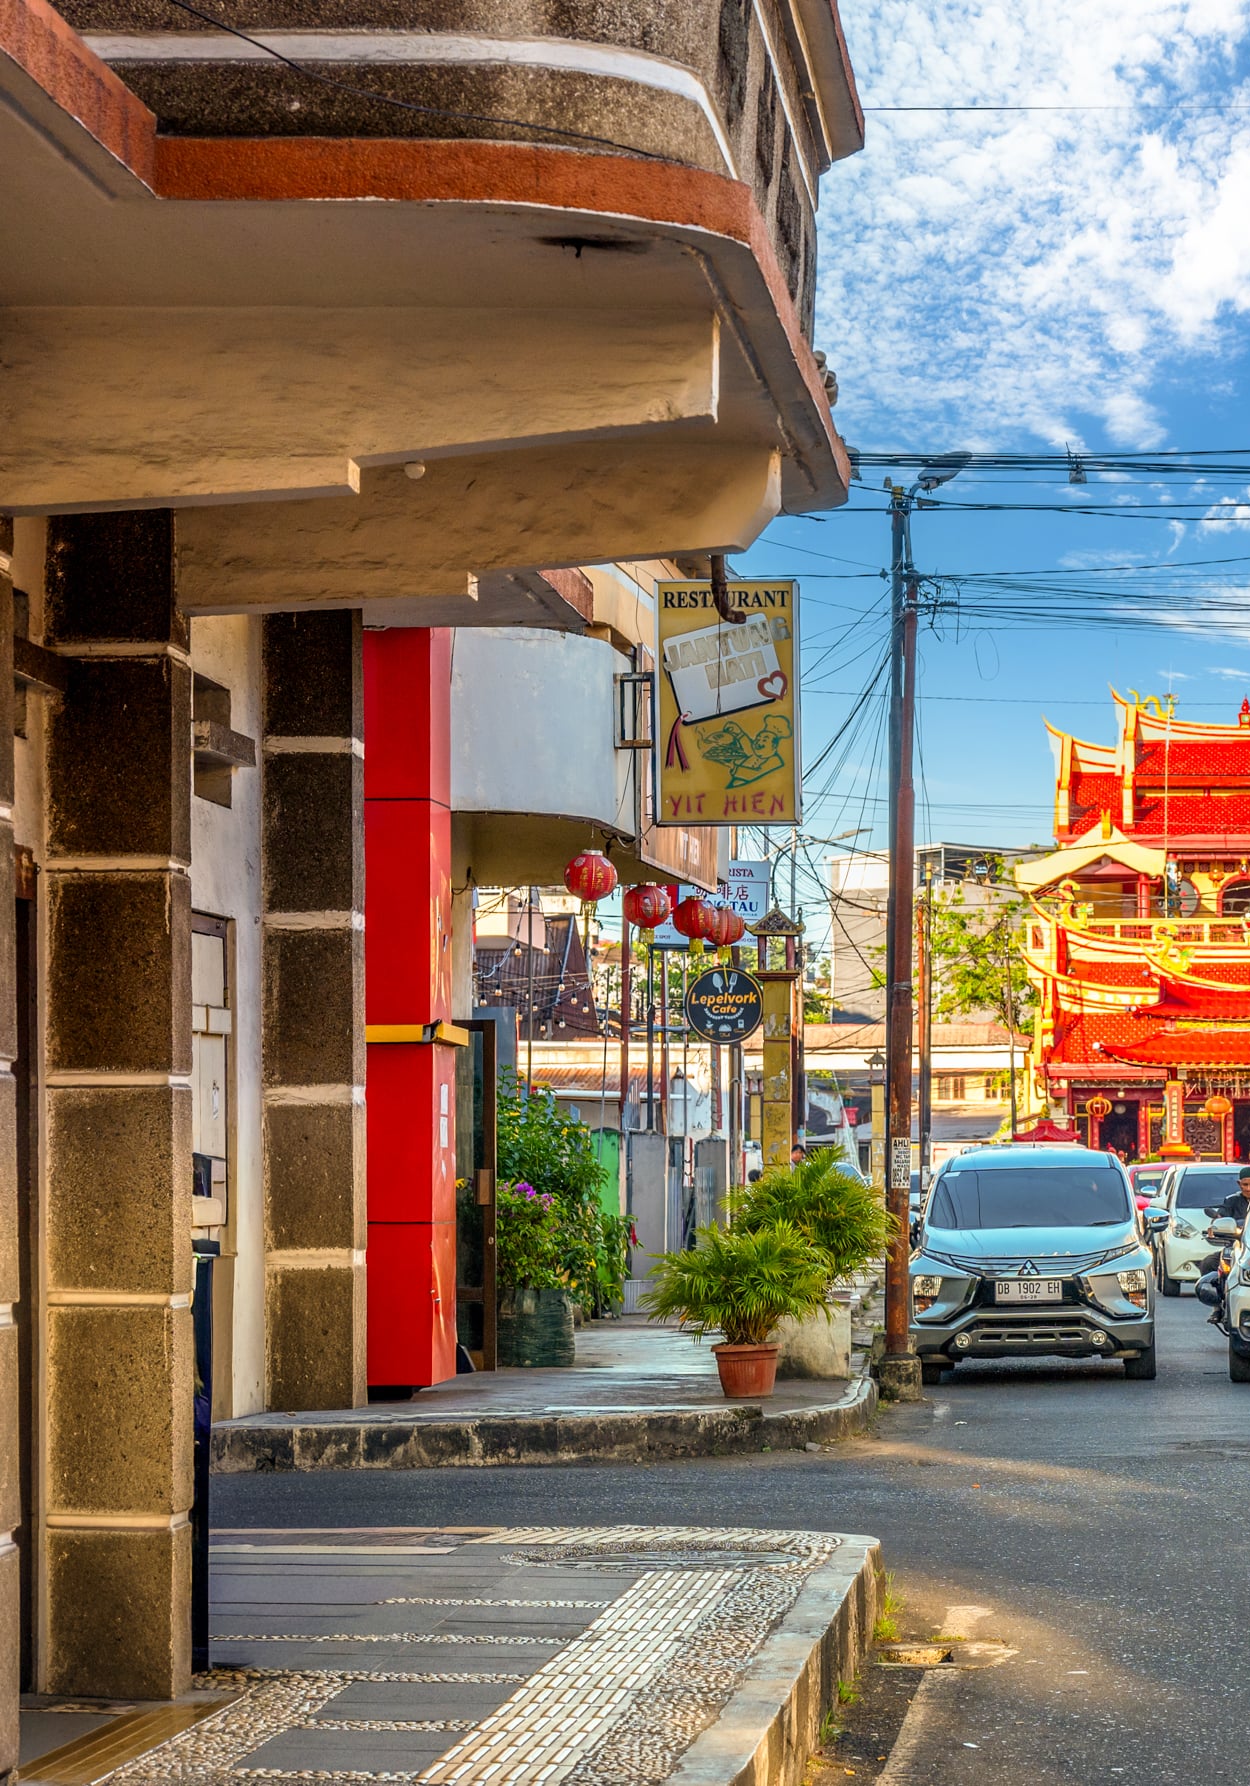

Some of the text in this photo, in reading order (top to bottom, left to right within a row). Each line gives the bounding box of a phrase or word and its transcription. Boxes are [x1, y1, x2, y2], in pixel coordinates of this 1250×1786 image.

[663, 590, 789, 608] RESTURANT
[670, 791, 785, 817] YIT HIEN
[729, 901, 759, 912] TAU
[691, 992, 757, 1007] Lepelvork
[712, 1005, 737, 1014] Cafe
[893, 1139, 909, 1147] AHLI
[997, 1282, 1060, 1295] DB 1902 EH
